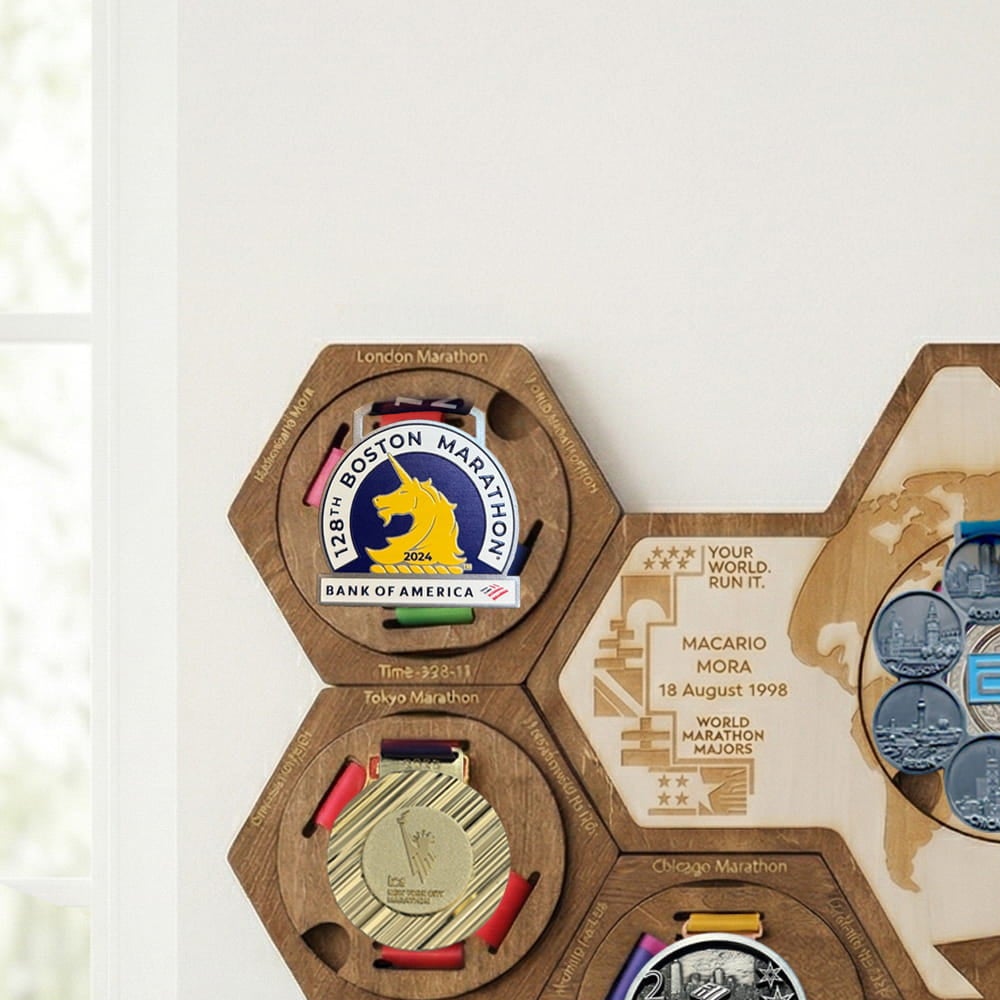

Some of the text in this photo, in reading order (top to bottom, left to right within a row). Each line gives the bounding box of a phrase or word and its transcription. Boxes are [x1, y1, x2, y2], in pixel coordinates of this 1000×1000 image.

[356, 349, 489, 363] London Marathon
[329, 496, 348, 559] 128TH
[340, 431, 422, 488] BOSTON
[437, 435, 507, 558] MARATHON
[403, 552, 432, 561] 2024
[708, 546, 753, 559] YOUR
[708, 561, 772, 574] WORLD.
[709, 576, 766, 589] RUN IT.
[326, 585, 474, 597] BANK OF AMERICA
[682, 636, 767, 651] MACARIO
[696, 659, 752, 673] MORA
[363, 689, 480, 706] Tokyo Marathon
[658, 683, 788, 700] 18 August 1998
[696, 717, 750, 728] WORLD
[682, 730, 765, 742] MARATHON
[694, 743, 753, 755] MAJORS
[715, 858, 788, 873] Marathon
